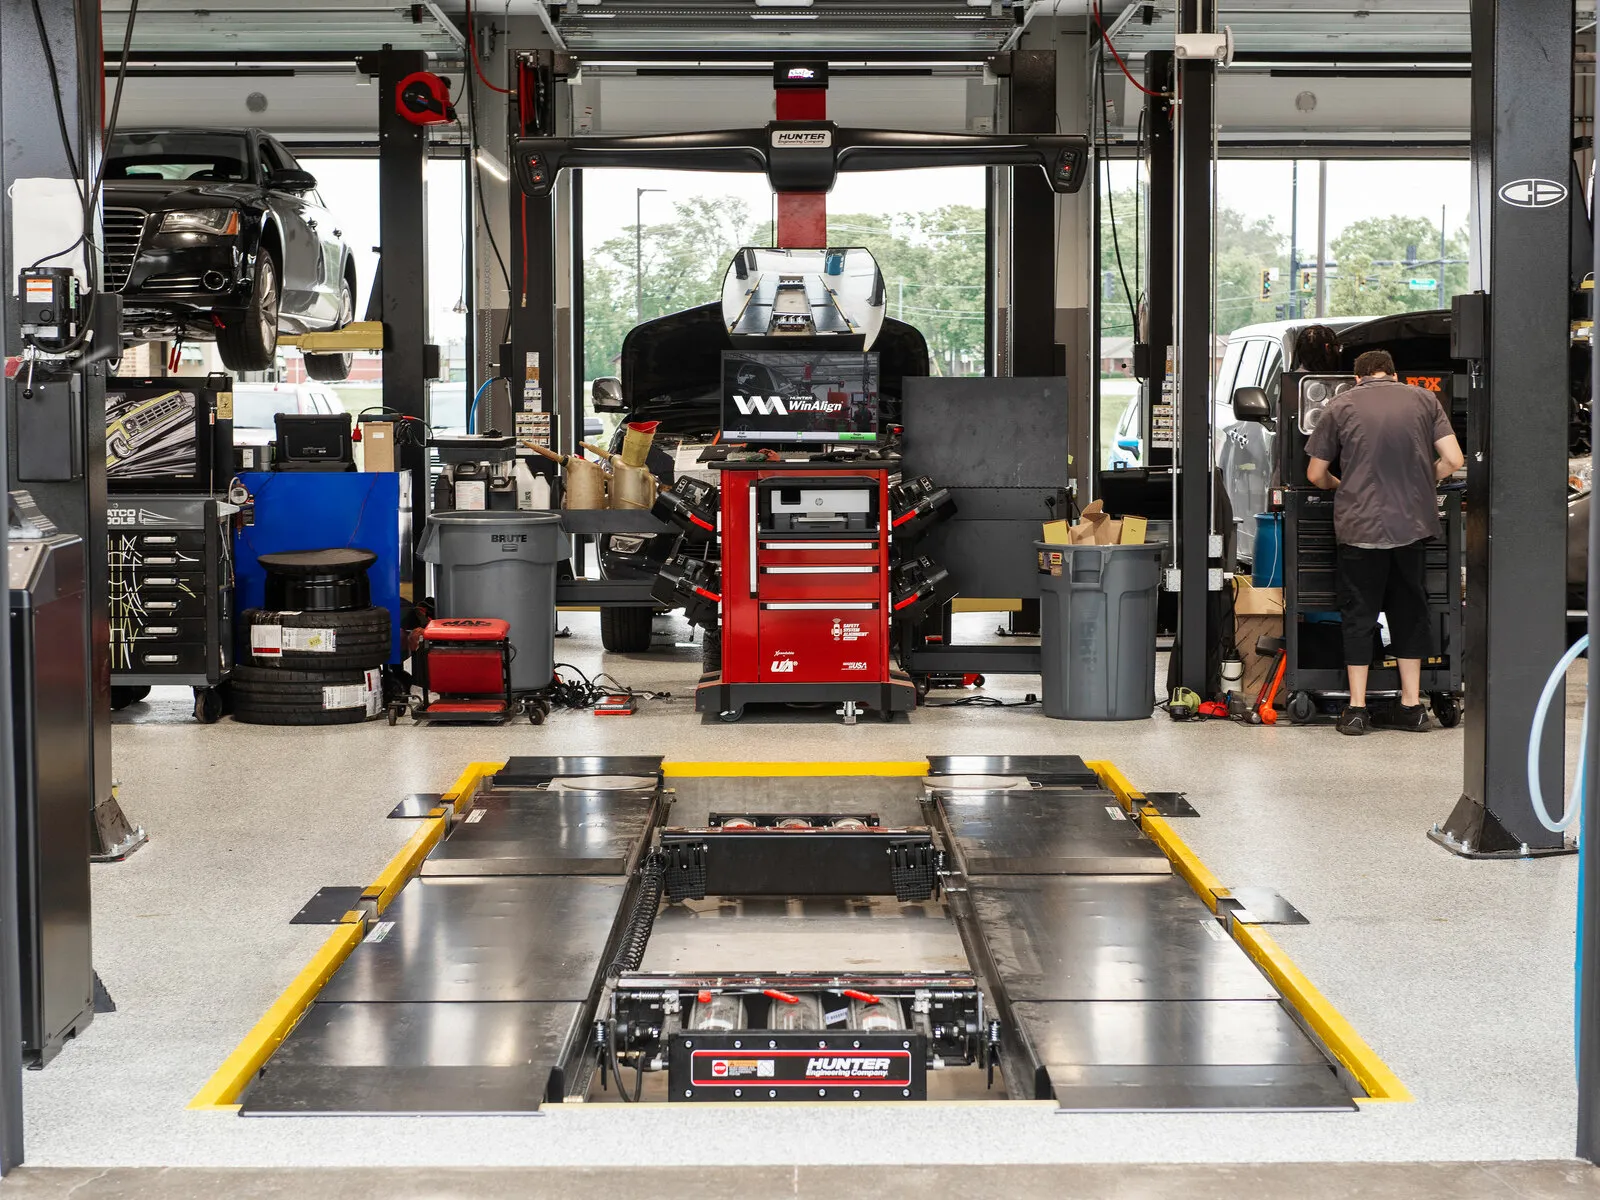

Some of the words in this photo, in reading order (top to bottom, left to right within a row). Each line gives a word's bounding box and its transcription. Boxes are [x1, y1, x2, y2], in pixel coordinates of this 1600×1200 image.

[1406, 376, 1441, 391] FOX
[789, 400, 842, 412] WinAlign
[107, 509, 136, 517] ATCO
[491, 534, 528, 543] BRUTE
[807, 1057, 890, 1070] HUNTER
[806, 1069, 850, 1077] Engineering
[850, 1069, 888, 1077] Company
